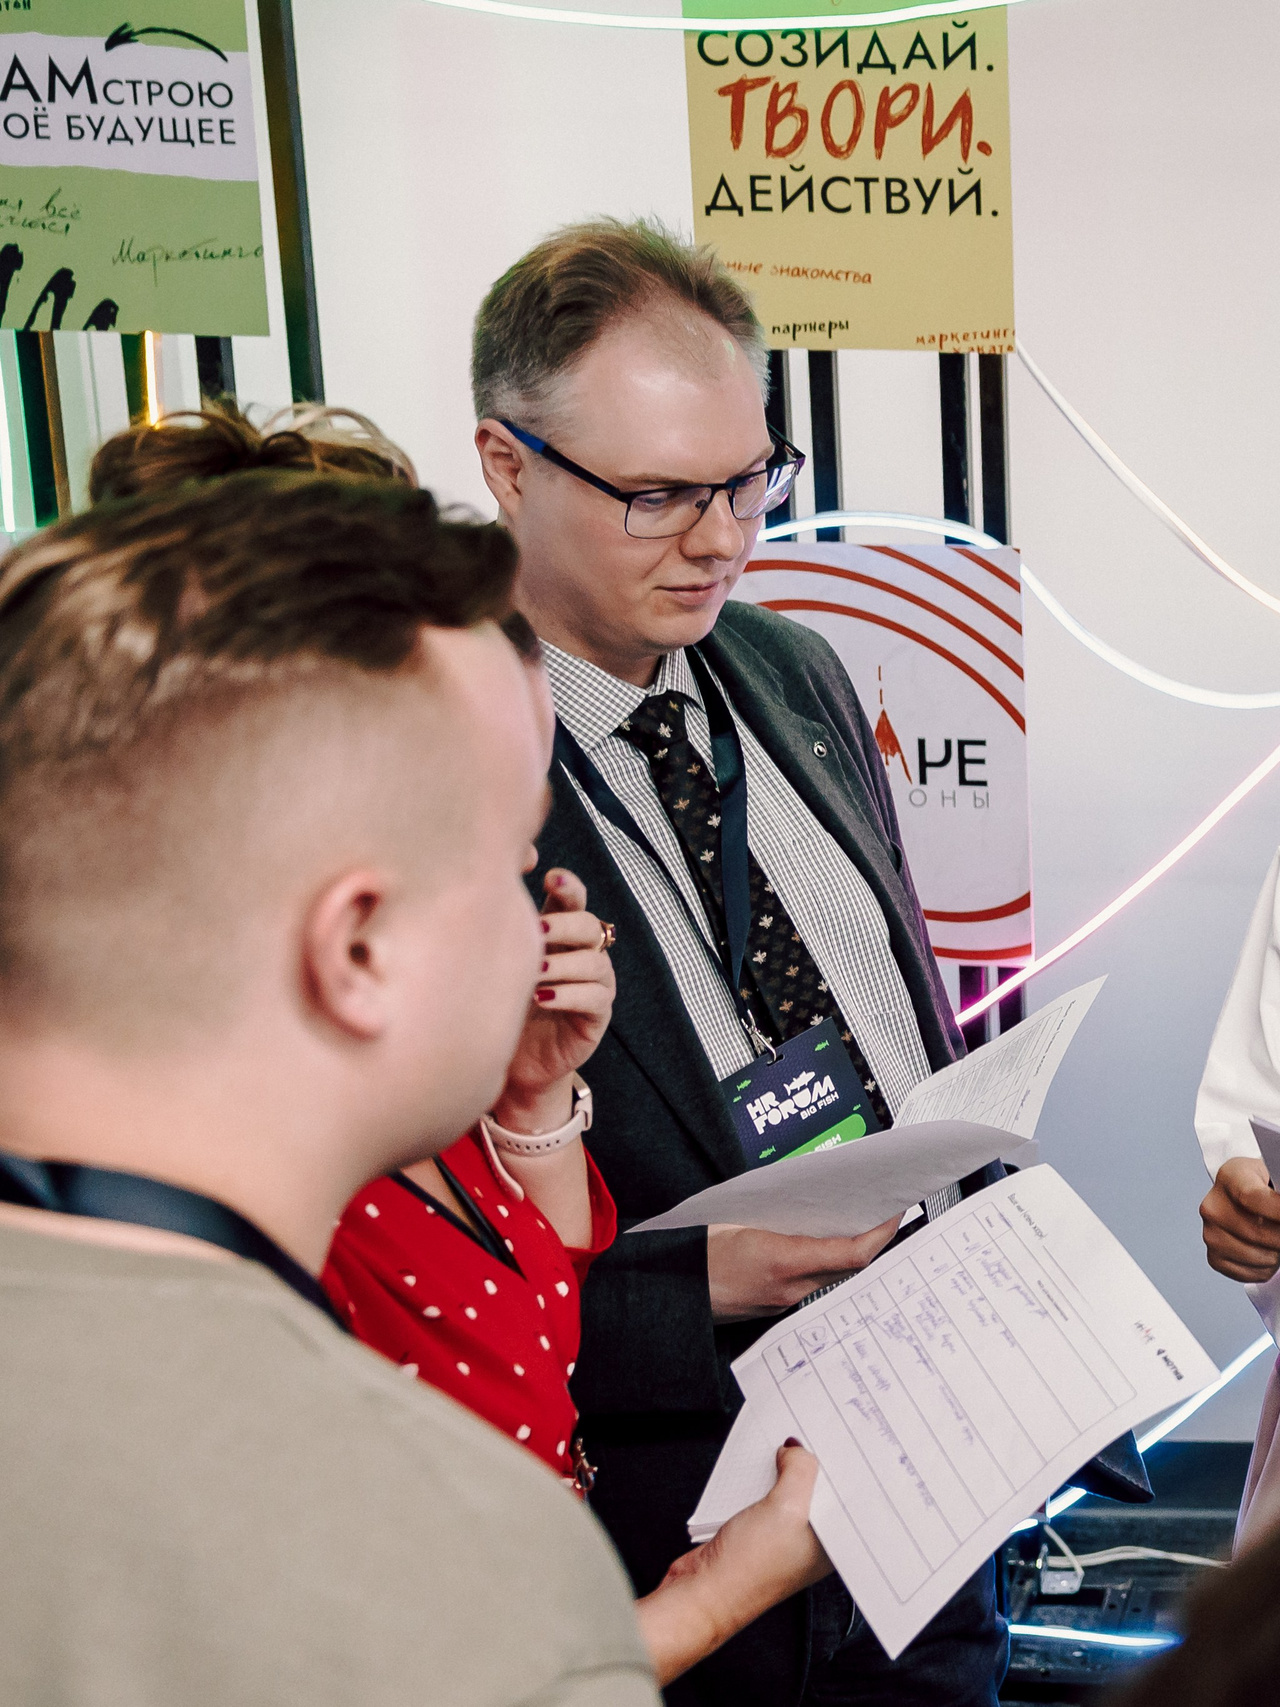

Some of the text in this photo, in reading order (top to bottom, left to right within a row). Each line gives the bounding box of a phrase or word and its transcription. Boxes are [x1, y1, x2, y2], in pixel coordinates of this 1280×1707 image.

[697, 20, 995, 75] СОЗИДАЙ.
[102, 79, 234, 108] СТРОЮ
[3, 106, 237, 148] ОЁ БУДУЩЕЕ
[716, 74, 993, 165] ТВОРИ.
[704, 163, 999, 218] ДЕЙСТВУЙ.
[770, 264, 873, 285] знакомства
[771, 320, 850, 341] партнеры
[746, 1091, 780, 1120] HR
[753, 1075, 836, 1135] FORUM
[800, 1091, 839, 1121] BIG FISH
